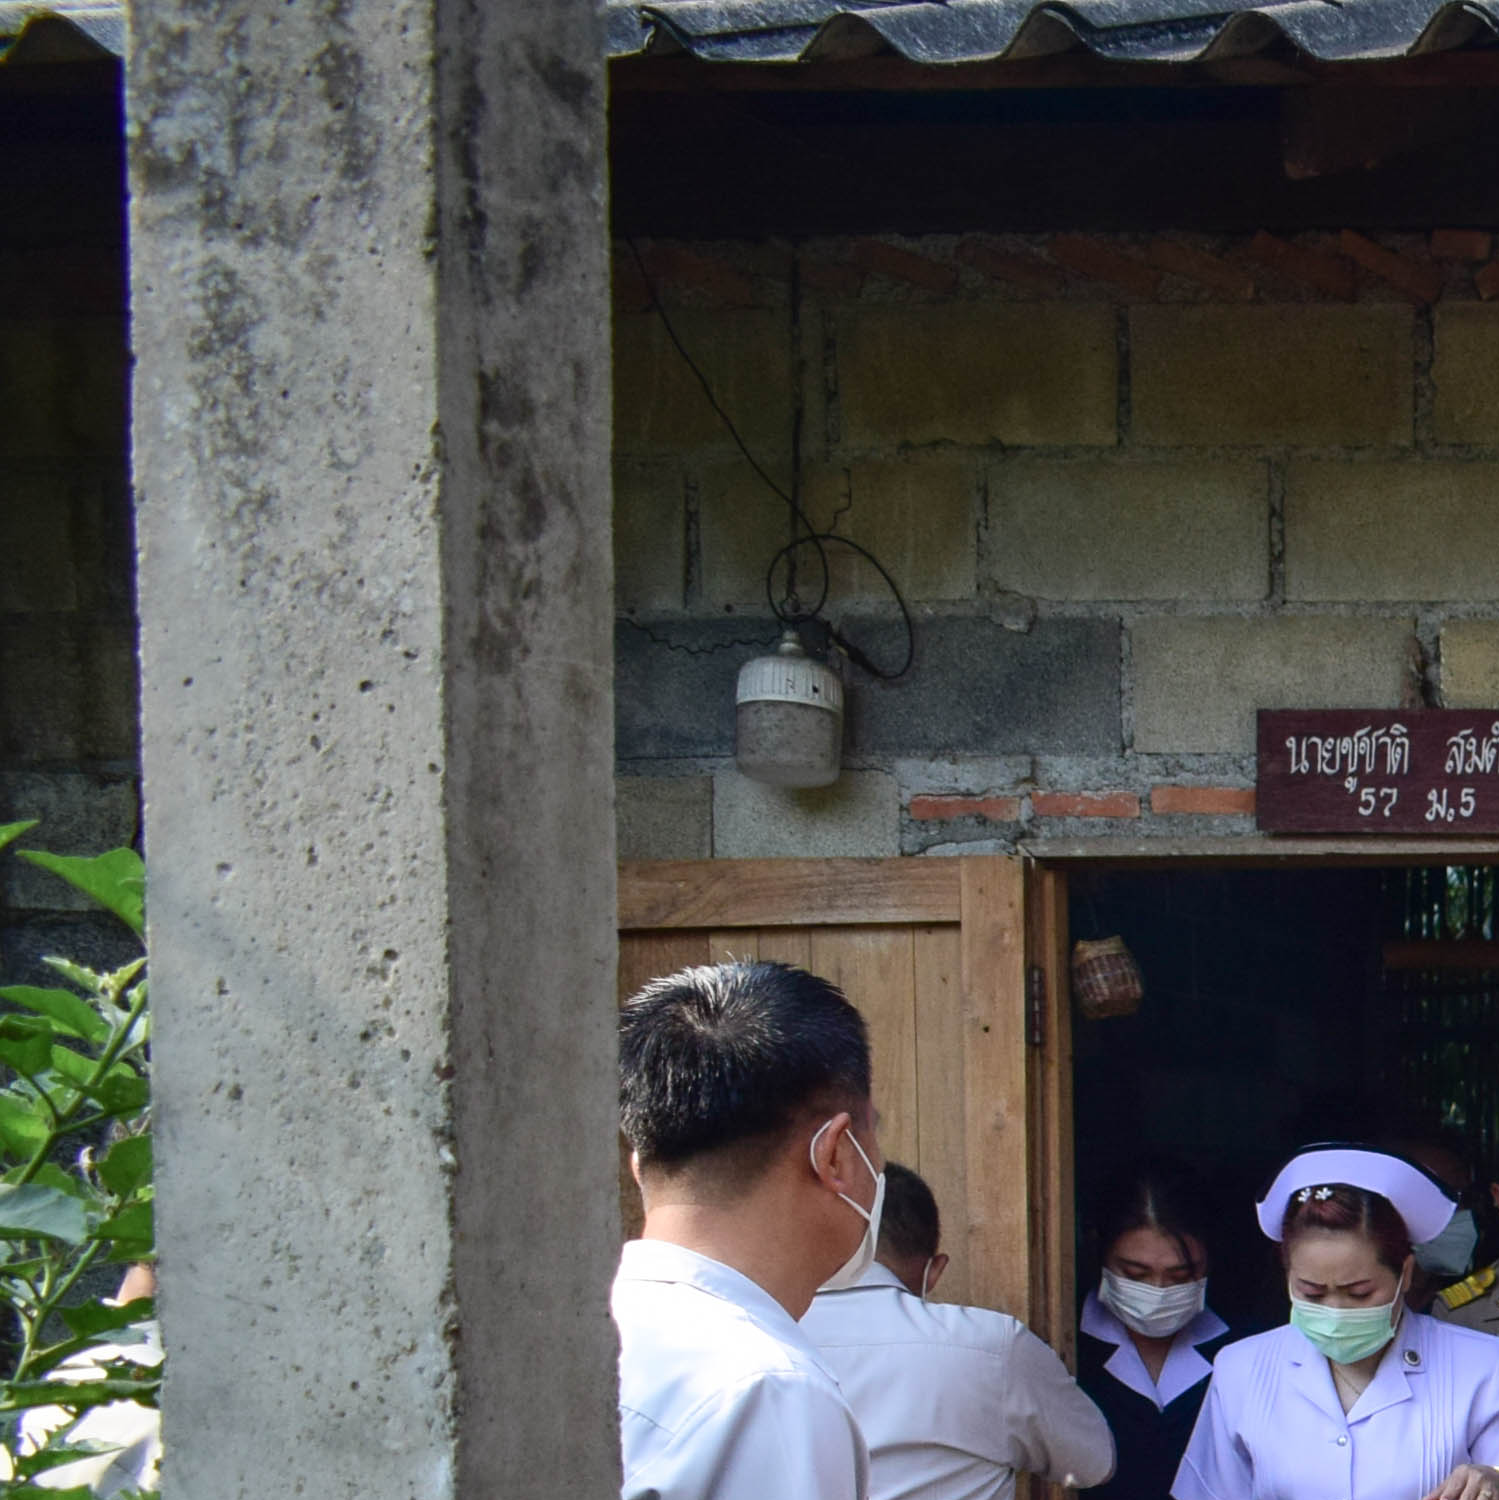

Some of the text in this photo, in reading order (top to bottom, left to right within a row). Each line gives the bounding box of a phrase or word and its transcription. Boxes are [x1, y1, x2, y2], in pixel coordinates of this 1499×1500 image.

[1286, 723, 1409, 793] นายชูชาติ
[1358, 788, 1475, 822] 57 ม.5
